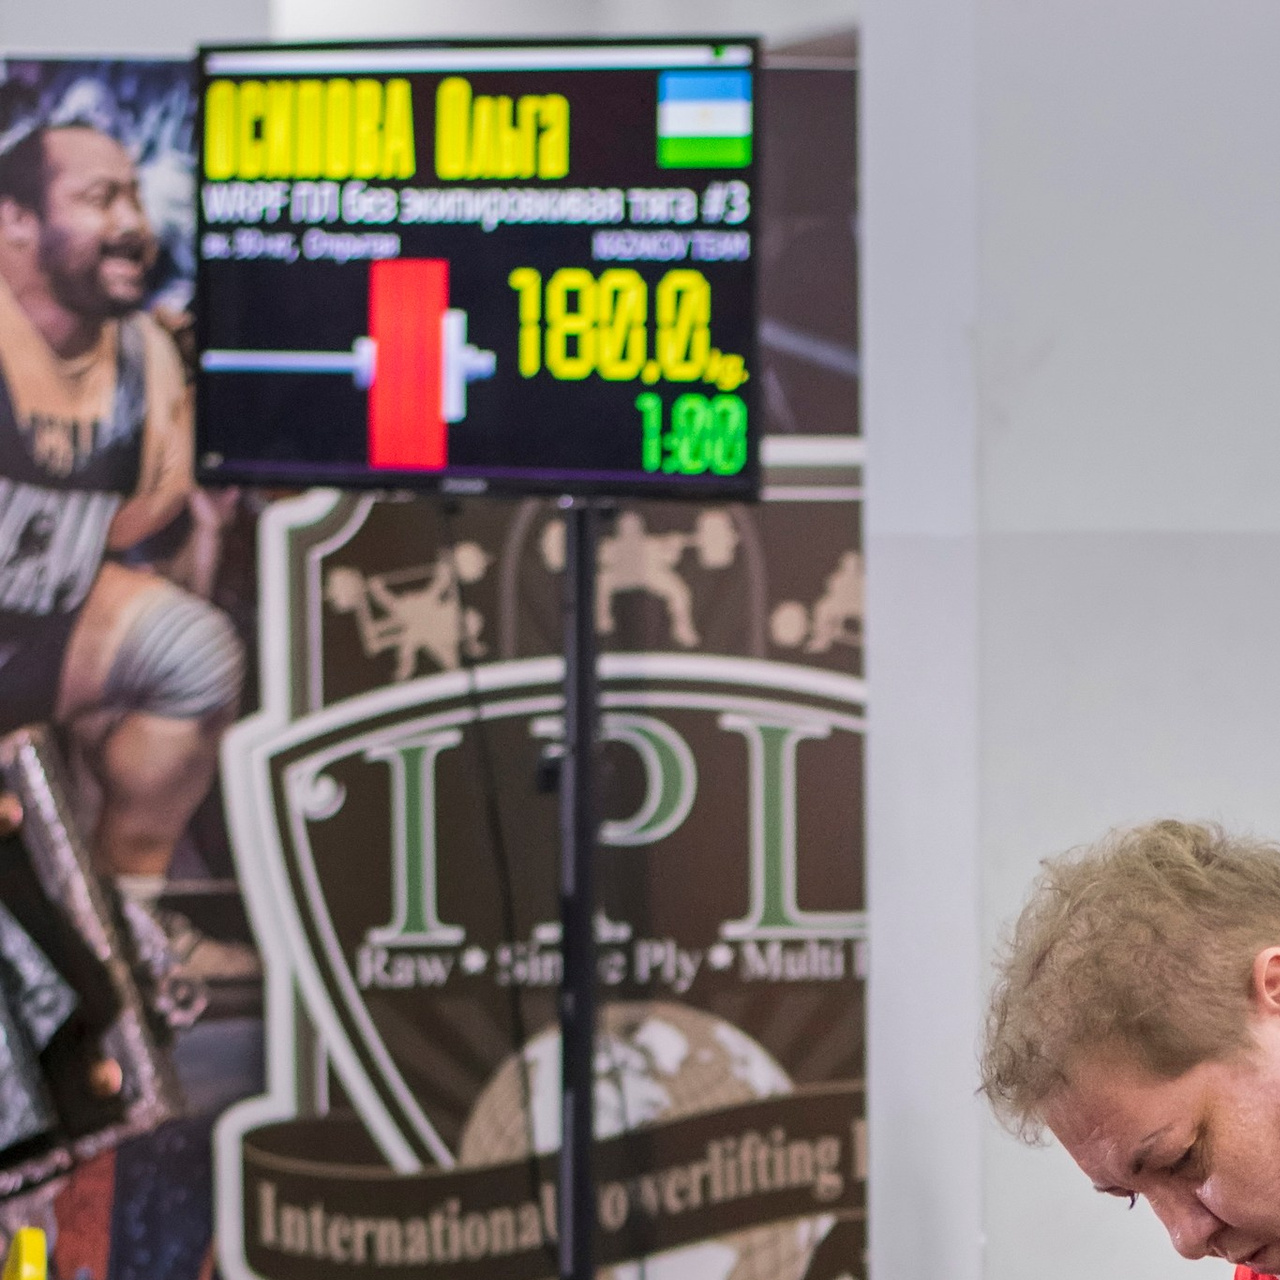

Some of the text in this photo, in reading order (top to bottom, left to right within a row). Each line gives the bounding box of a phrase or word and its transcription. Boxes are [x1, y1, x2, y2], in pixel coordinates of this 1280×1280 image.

[700, 180, 751, 225] #3
[508, 268, 711, 385] 180.0
[635, 393, 748, 475] 1:00
[356, 942, 456, 990] Raw
[495, 940, 627, 987] Sine
[634, 938, 703, 994] Ply
[739, 937, 845, 983] Multi
[256, 1179, 560, 1268] International
[597, 1130, 844, 1232] owerlifting
